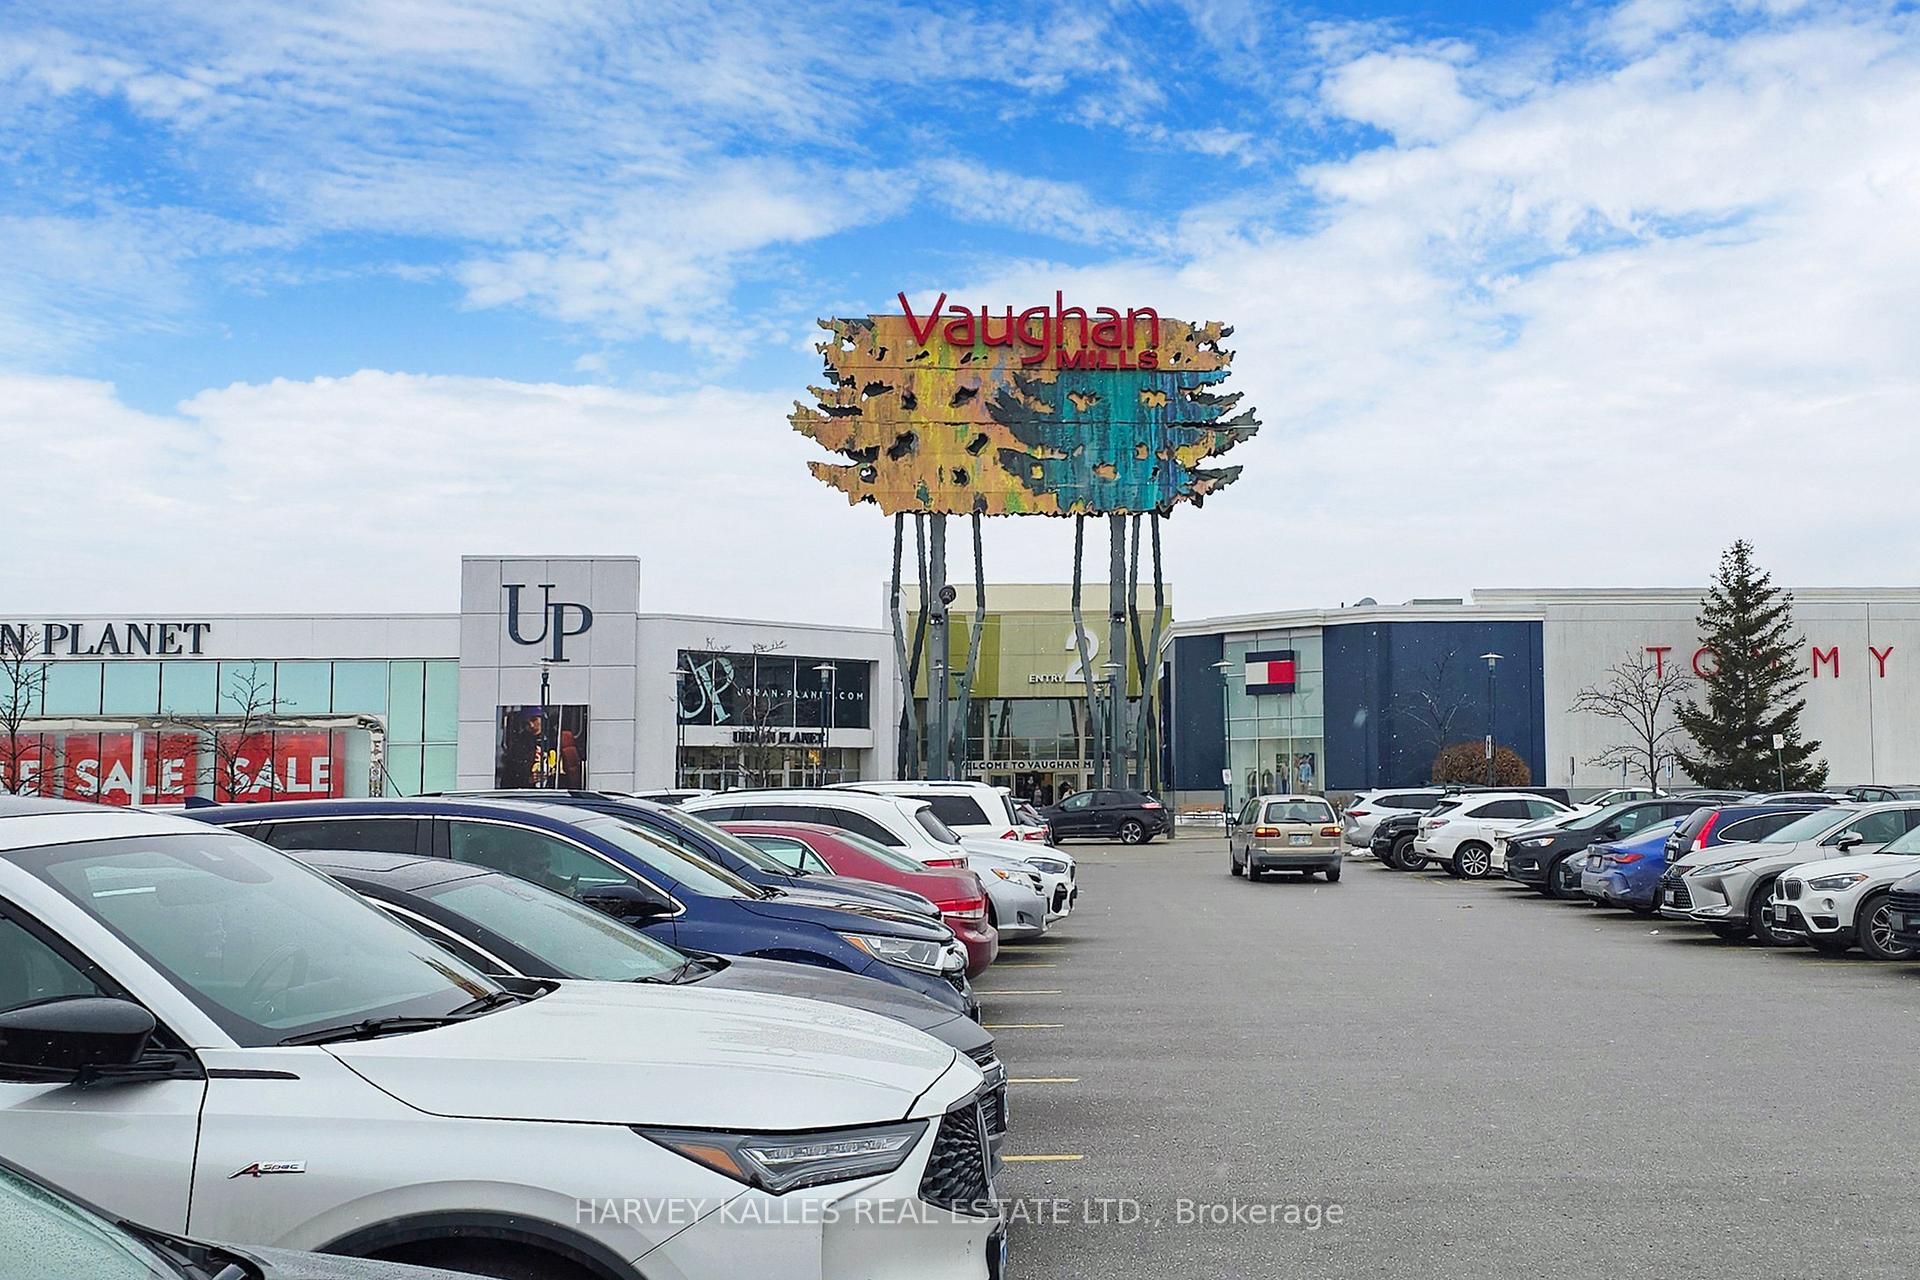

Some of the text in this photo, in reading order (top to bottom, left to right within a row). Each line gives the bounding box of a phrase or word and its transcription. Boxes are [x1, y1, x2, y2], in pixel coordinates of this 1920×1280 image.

[898, 290, 1159, 365] Vaughan
[1056, 350, 1159, 369] MILLS
[42, 623, 211, 655] PLANET
[502, 584, 593, 662] UP
[1065, 629, 1100, 682] 2
[1646, 646, 1895, 678] TOMY
[736, 687, 864, 700] URBAN-PLAN.COM
[1029, 674, 1064, 683] ENTRY
[733, 731, 776, 745] URBN
[75, 758, 185, 796] SALE
[227, 756, 334, 794] SALE
[1012, 761, 1025, 769] TO
[1028, 761, 1080, 770] VAUGHAN
